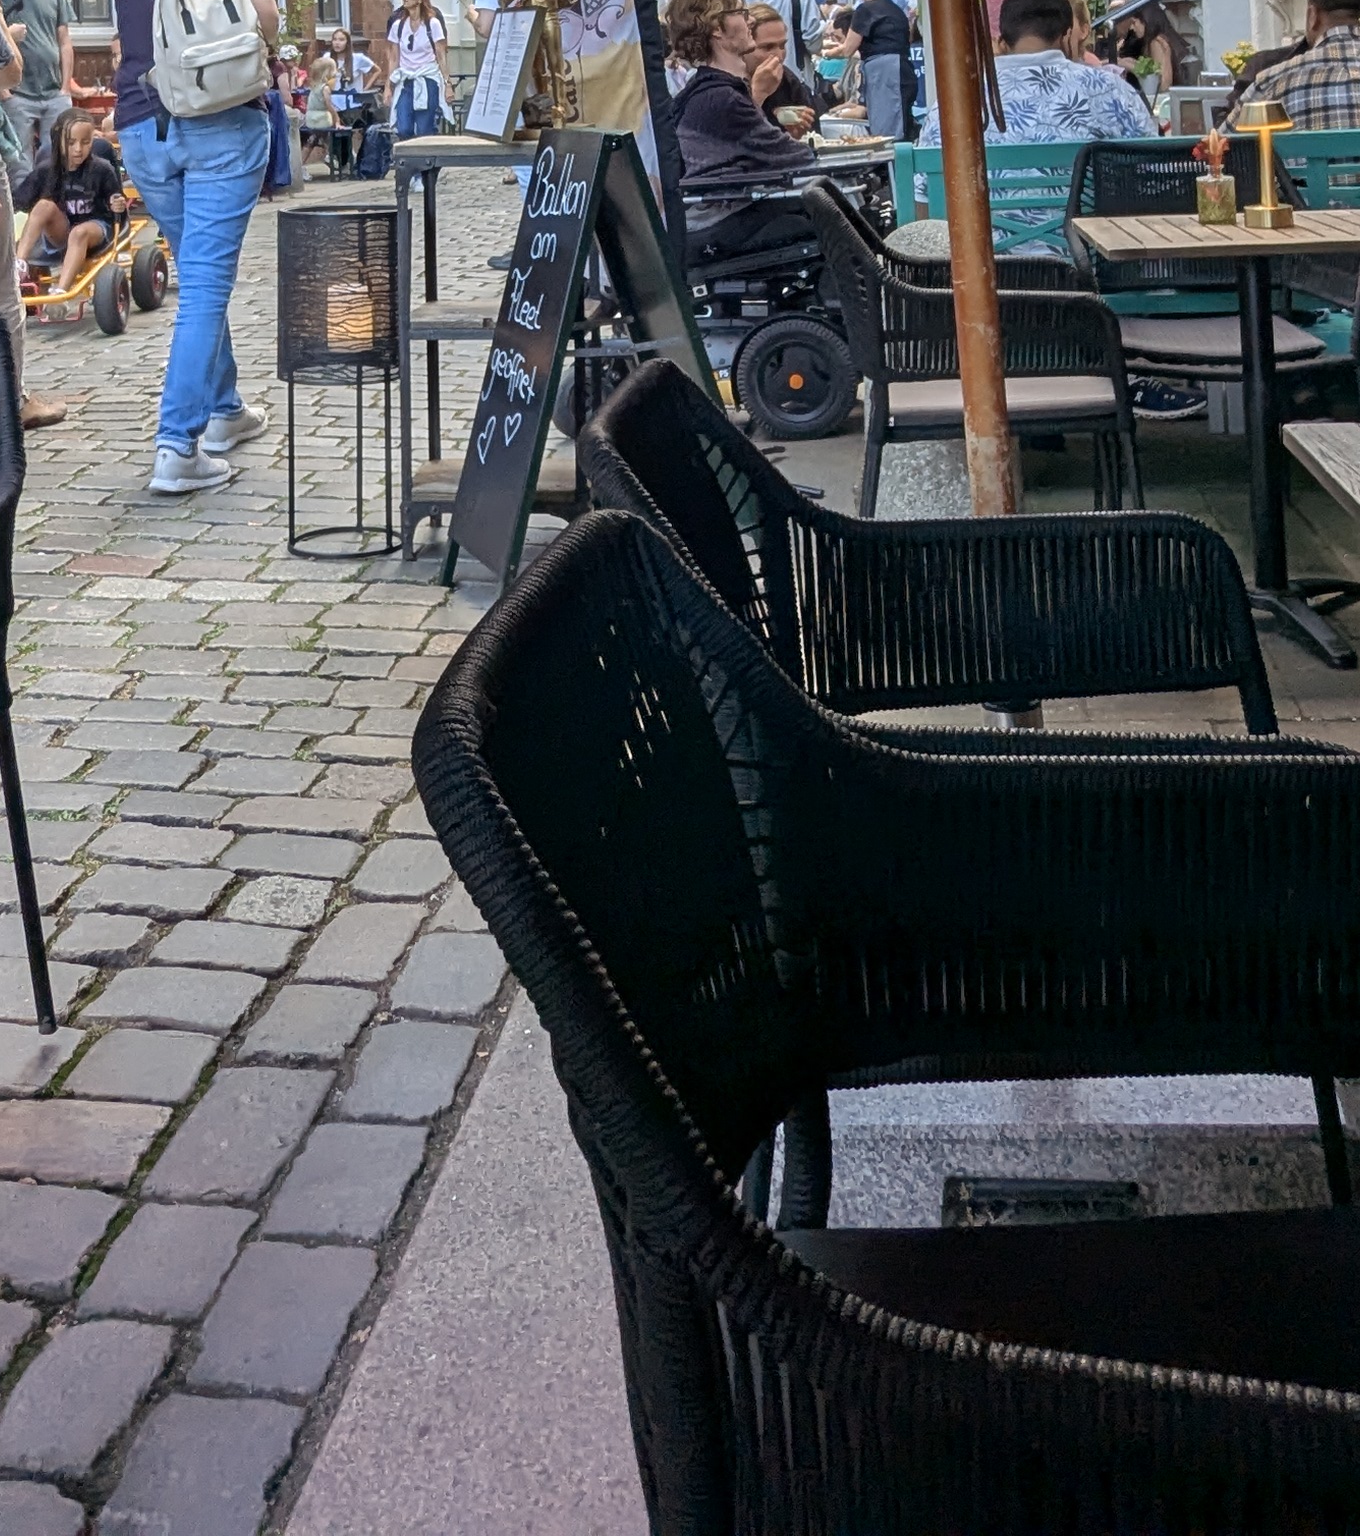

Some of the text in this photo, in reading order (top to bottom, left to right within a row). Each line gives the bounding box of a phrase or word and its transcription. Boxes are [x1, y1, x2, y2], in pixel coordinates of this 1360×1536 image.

[527, 145, 587, 220] Balkon
[508, 265, 545, 331] Fleet
[481, 347, 538, 405] geöffnet
